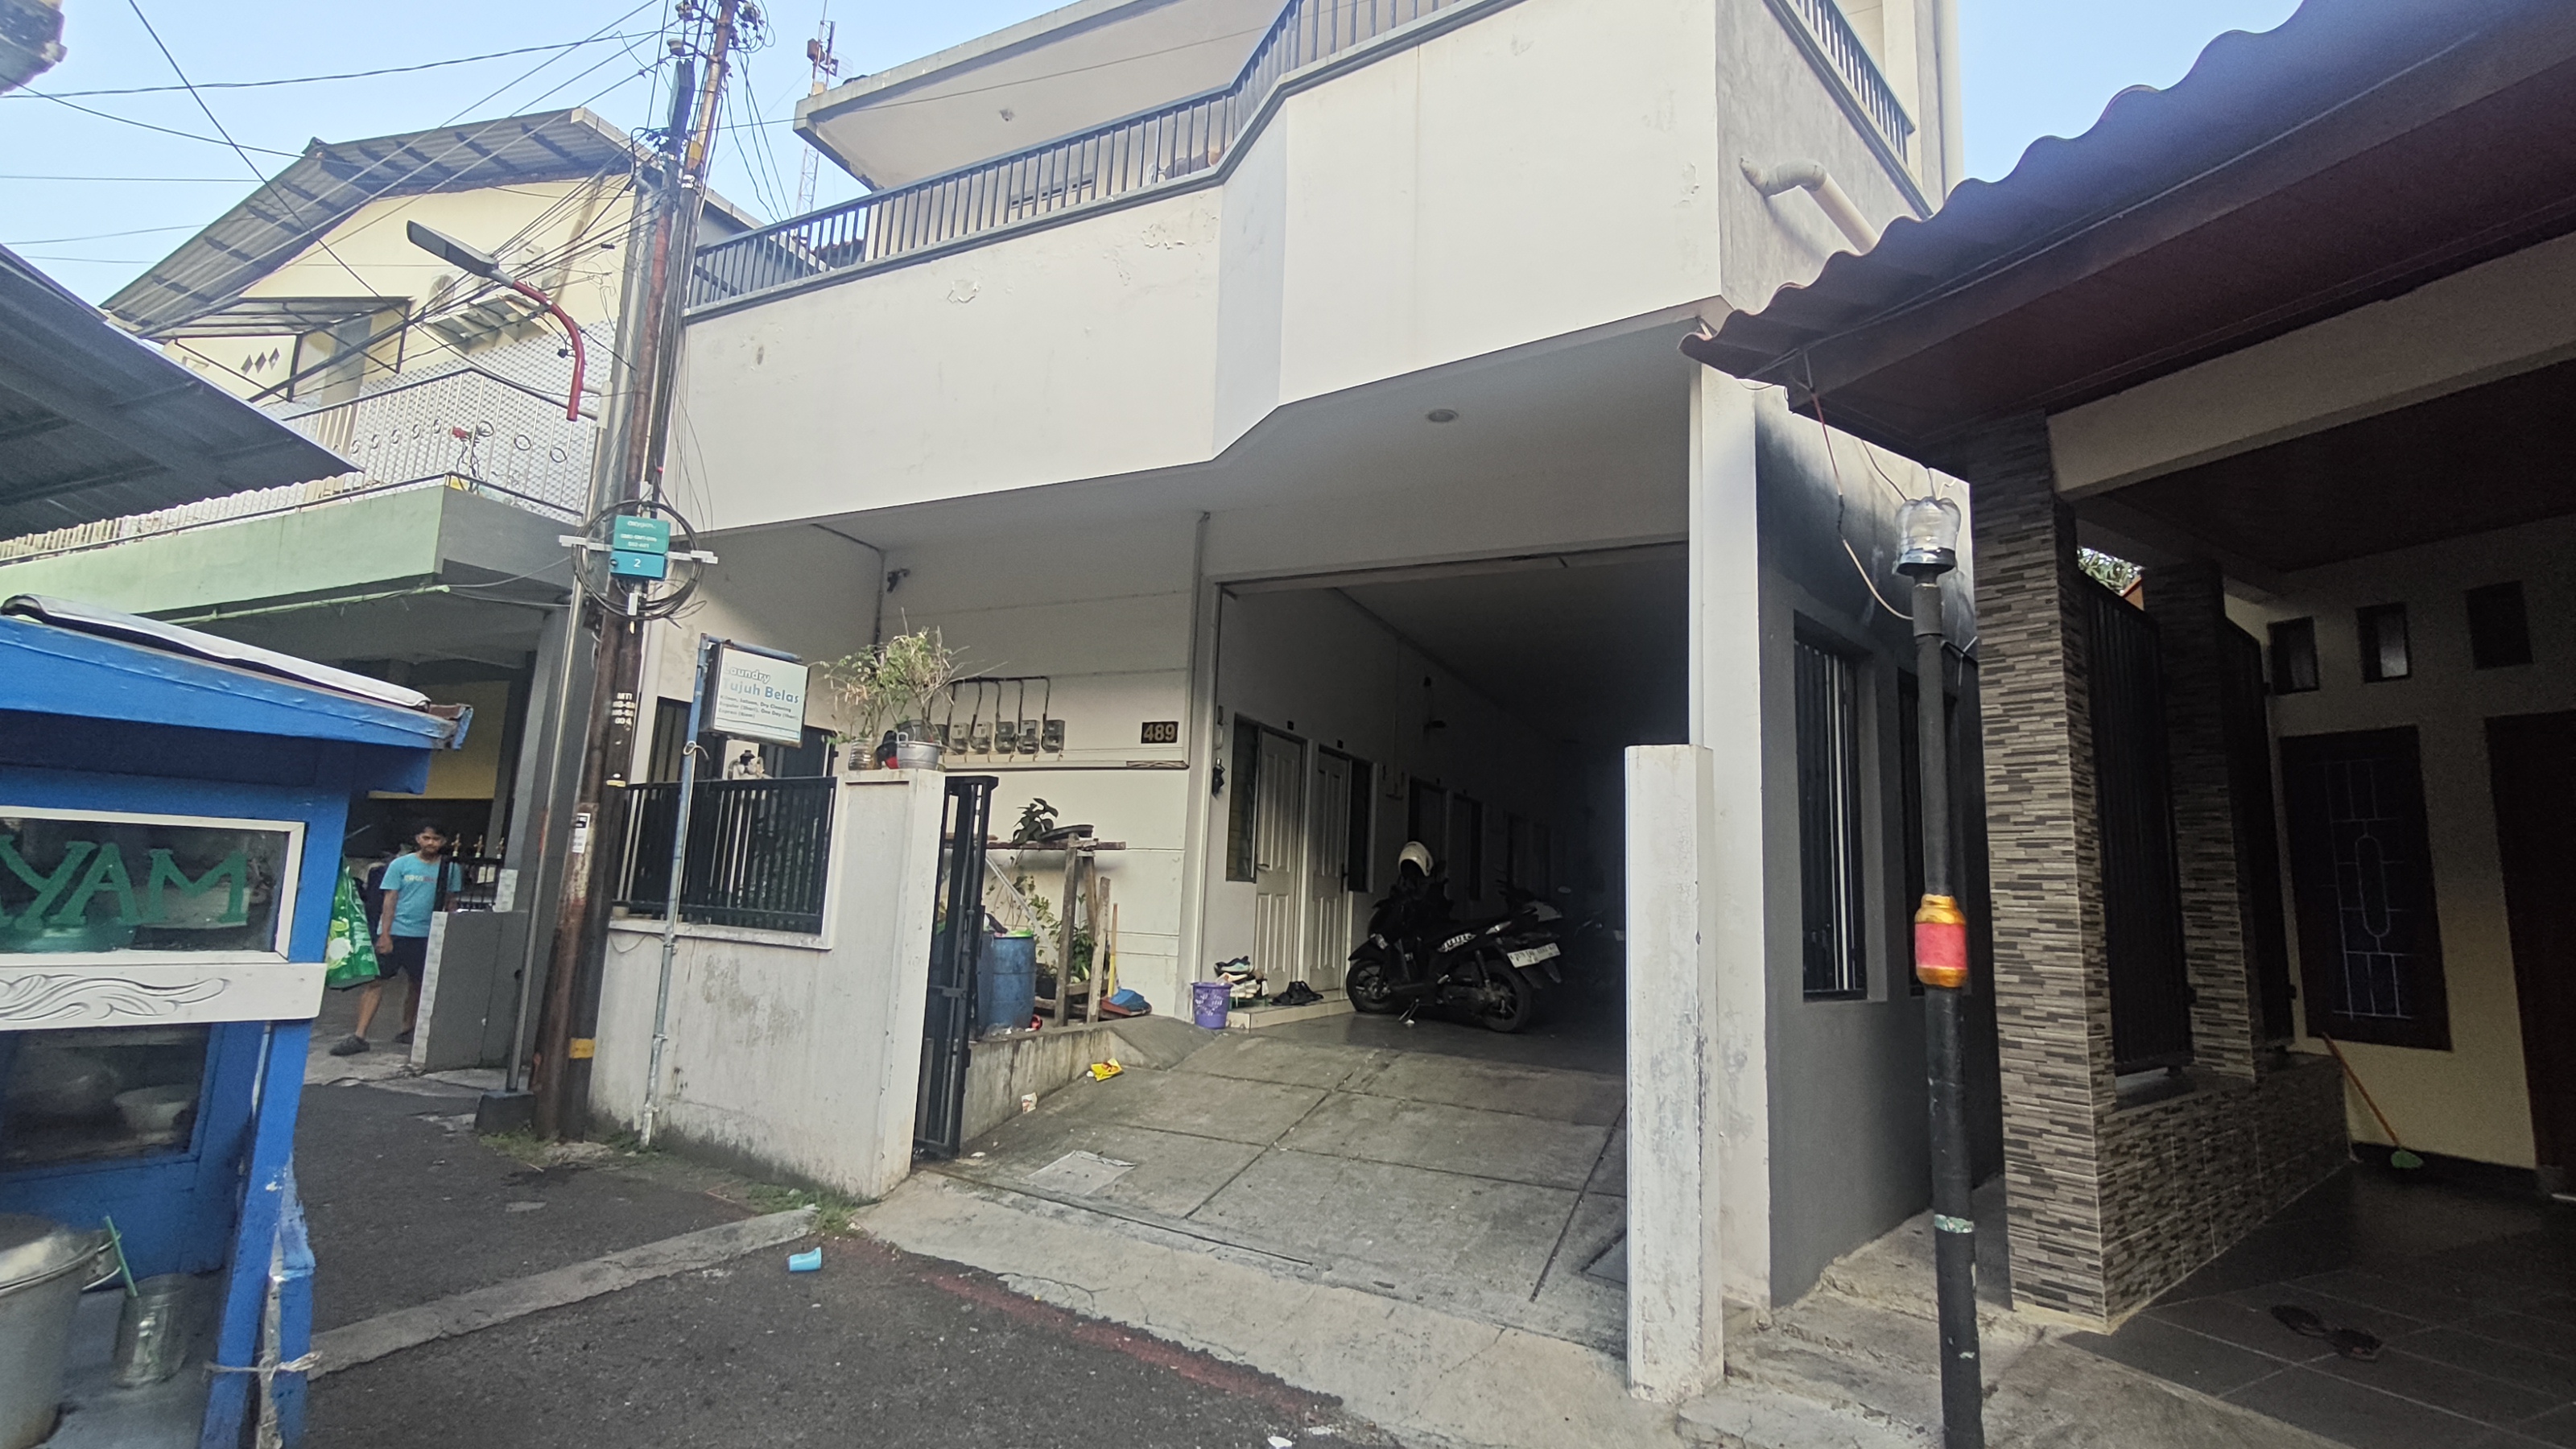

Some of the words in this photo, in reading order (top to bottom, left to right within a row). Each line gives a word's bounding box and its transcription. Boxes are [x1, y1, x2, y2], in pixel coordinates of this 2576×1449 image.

[634, 558, 642, 568] 2
[724, 663, 770, 684] Laundry
[723, 678, 760, 696] Tujuh
[765, 686, 799, 704] Belas
[1143, 724, 1175, 741] 489
[0, 835, 247, 930] YAM
